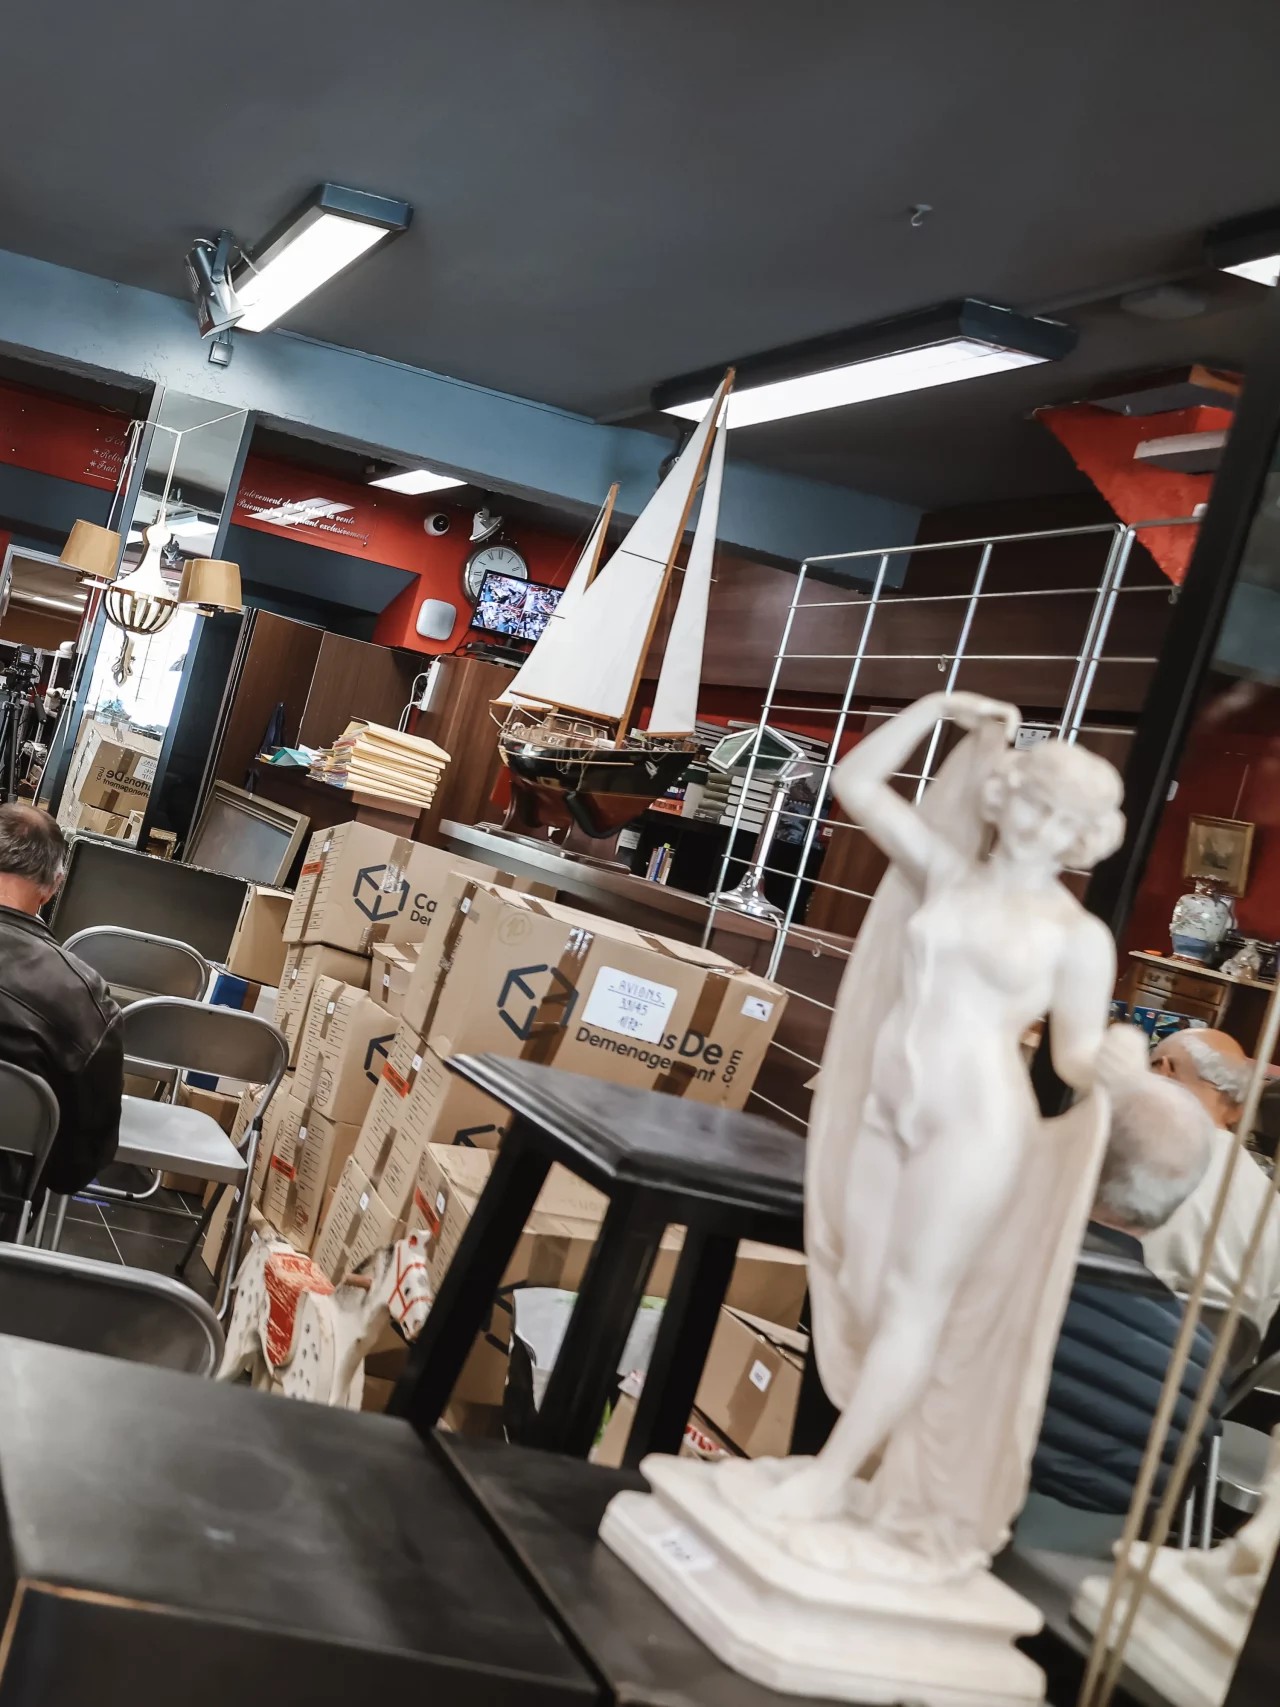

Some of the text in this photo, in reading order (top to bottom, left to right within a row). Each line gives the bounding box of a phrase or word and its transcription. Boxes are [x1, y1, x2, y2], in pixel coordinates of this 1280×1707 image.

[319, 521, 370, 541] exclusivement
[326, 510, 335, 519] la
[336, 515, 355, 525] vente
[575, 1026, 716, 1083] Demenagent
[721, 1049, 744, 1088] .com
